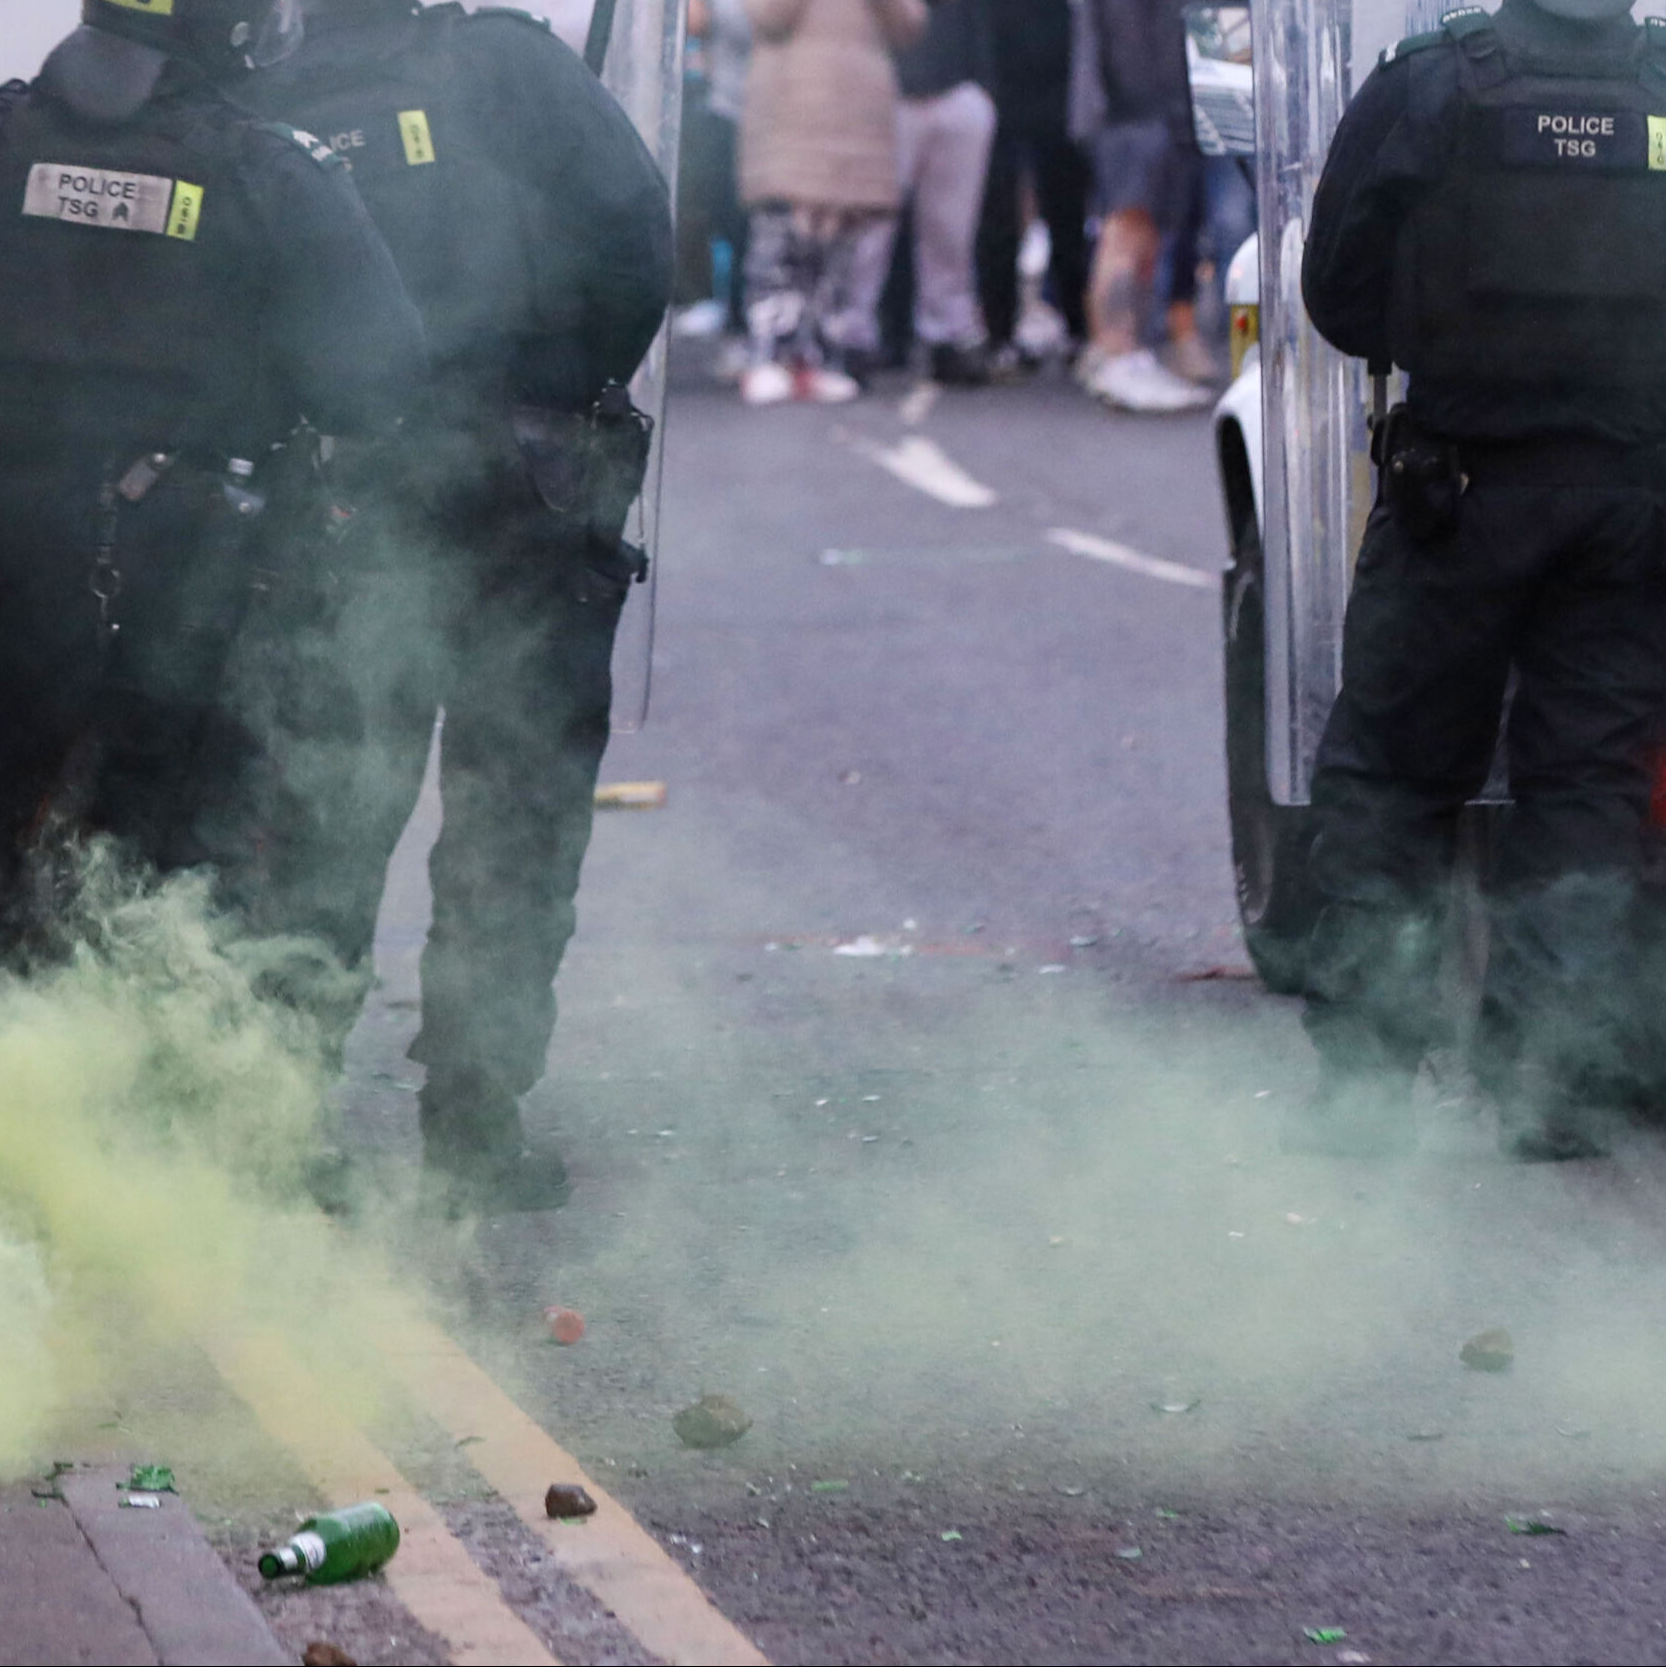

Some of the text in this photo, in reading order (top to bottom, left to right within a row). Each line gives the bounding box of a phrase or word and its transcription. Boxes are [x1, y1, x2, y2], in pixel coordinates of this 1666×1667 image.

[1537, 115, 1616, 136] POLICE
[1553, 138, 1597, 157] TSG
[58, 172, 137, 200] POLICE
[57, 195, 100, 219] TSG
